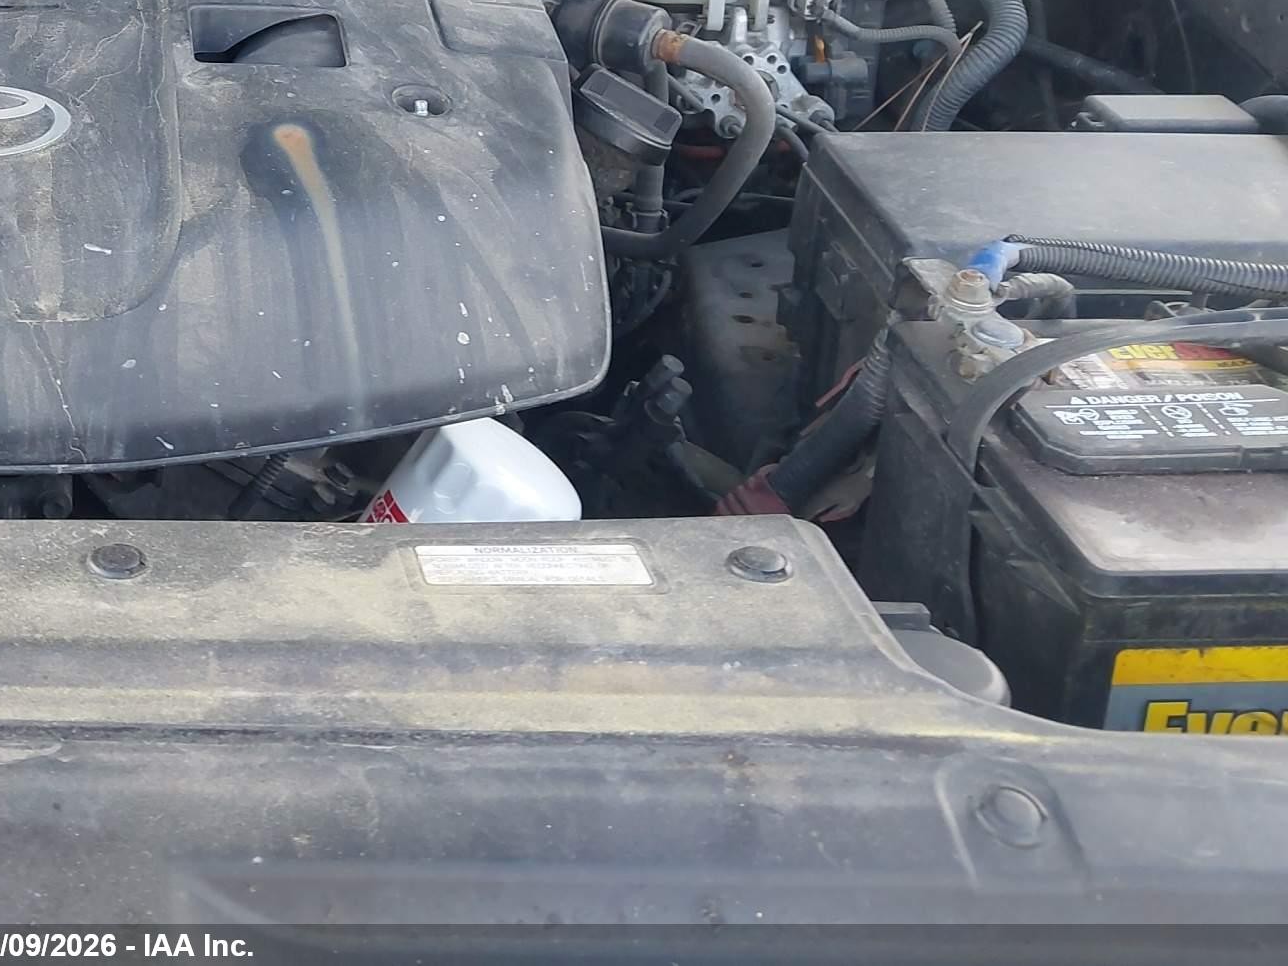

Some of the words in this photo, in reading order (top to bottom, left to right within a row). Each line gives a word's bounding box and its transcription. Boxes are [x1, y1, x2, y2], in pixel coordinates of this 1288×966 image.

[1086, 394, 1162, 405] DANGER
[1175, 392, 1245, 402] POISON
[473, 546, 579, 555] NORMALIZATION
[1143, 700, 1288, 734] Eve
